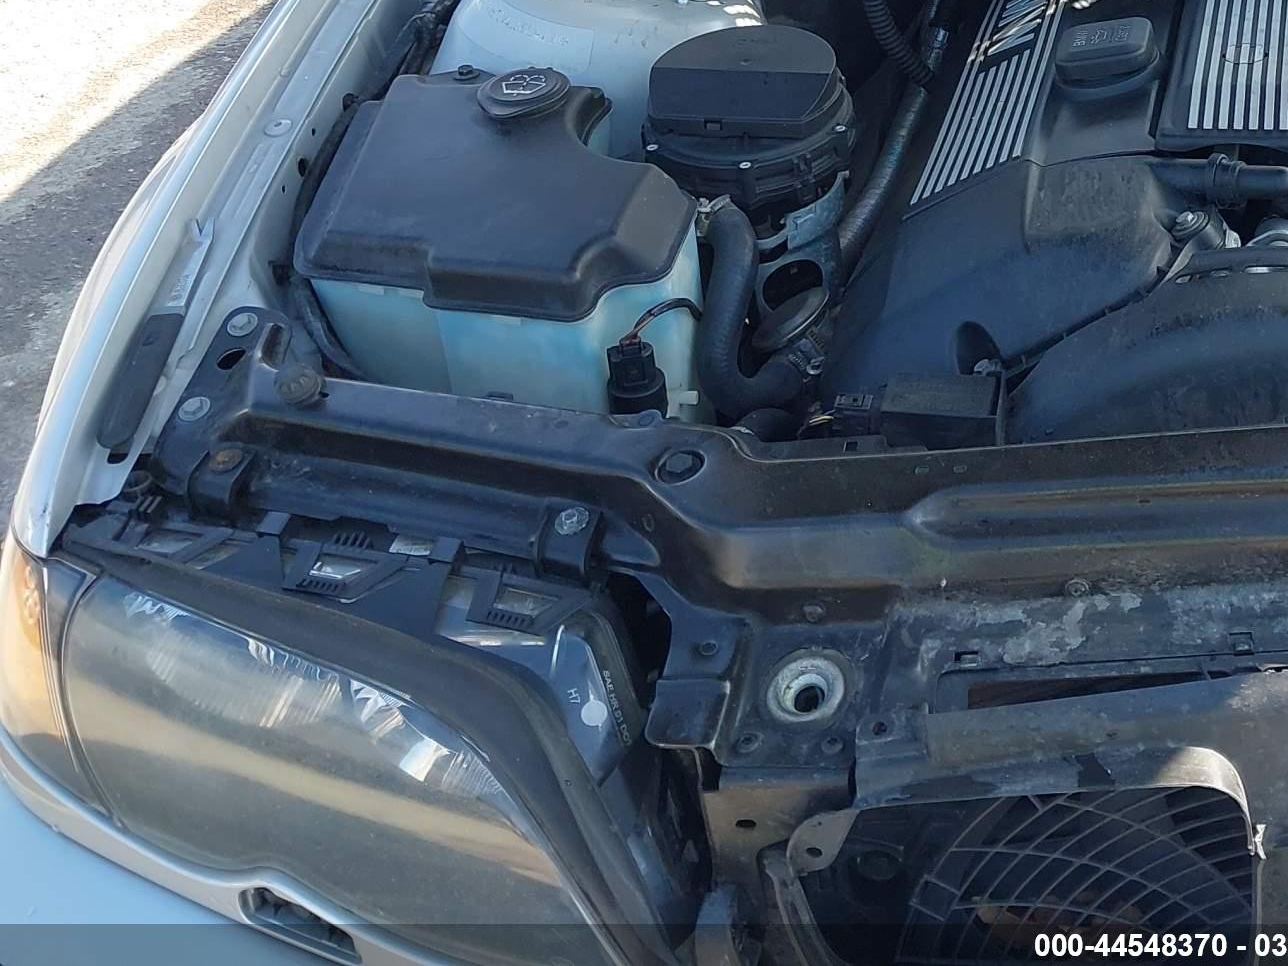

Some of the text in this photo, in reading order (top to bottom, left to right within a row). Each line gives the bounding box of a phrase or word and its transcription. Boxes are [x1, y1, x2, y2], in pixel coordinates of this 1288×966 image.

[567, 687, 581, 705] H7
[603, 670, 614, 691] SAE
[609, 694, 620, 711] HR
